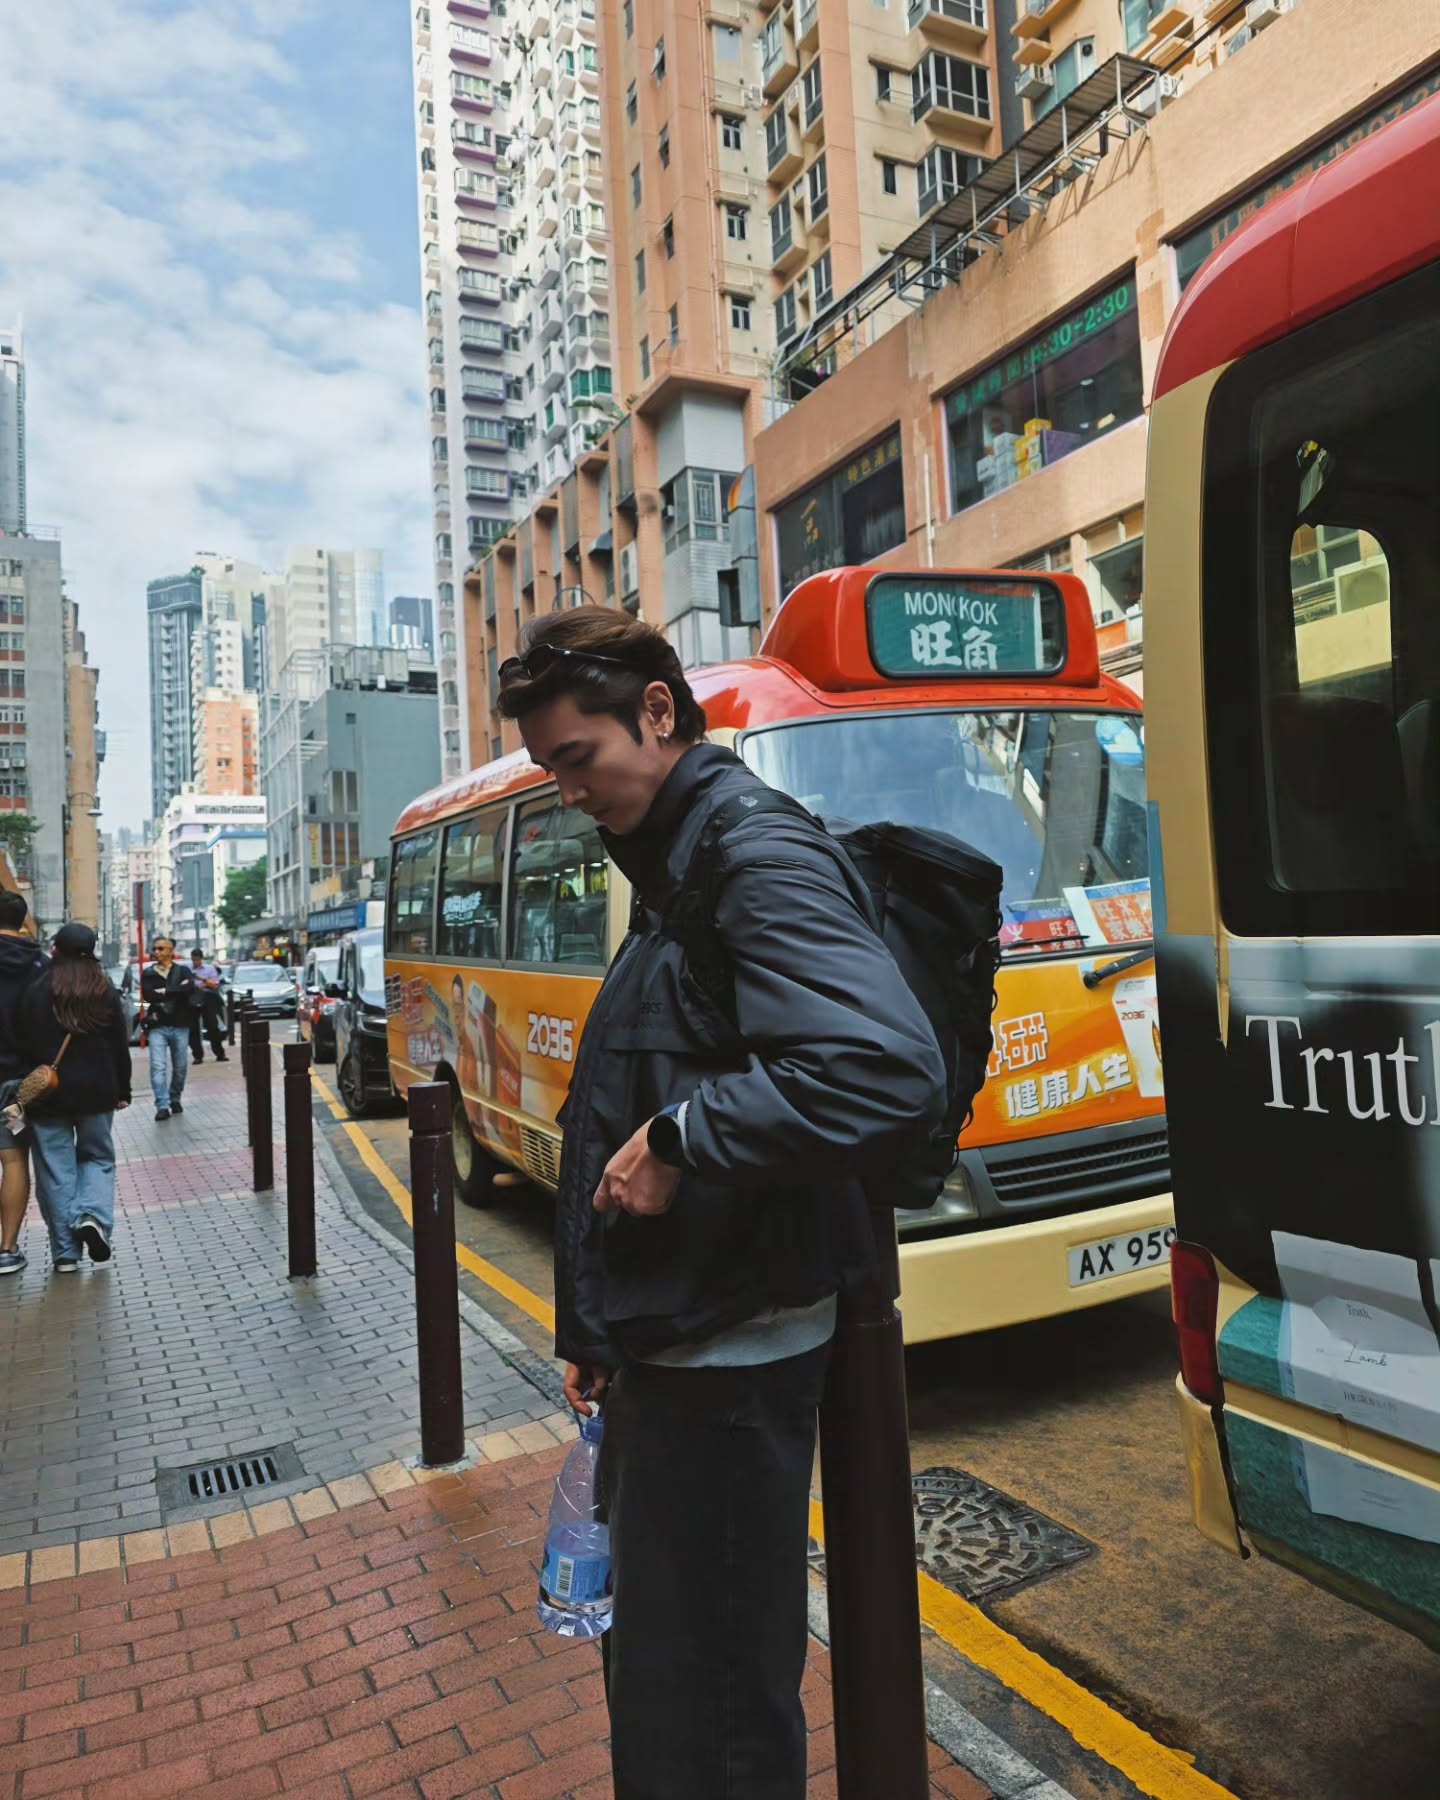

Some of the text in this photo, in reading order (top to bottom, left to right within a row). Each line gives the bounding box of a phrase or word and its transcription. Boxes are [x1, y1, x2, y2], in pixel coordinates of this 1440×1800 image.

[910, 620, 998, 670] 旺角
[527, 1011, 573, 1062] 2036
[1121, 1010, 1145, 1021] 2036
[1005, 1053, 1132, 1118] 健康人生
[1080, 1243, 1115, 1280] AX
